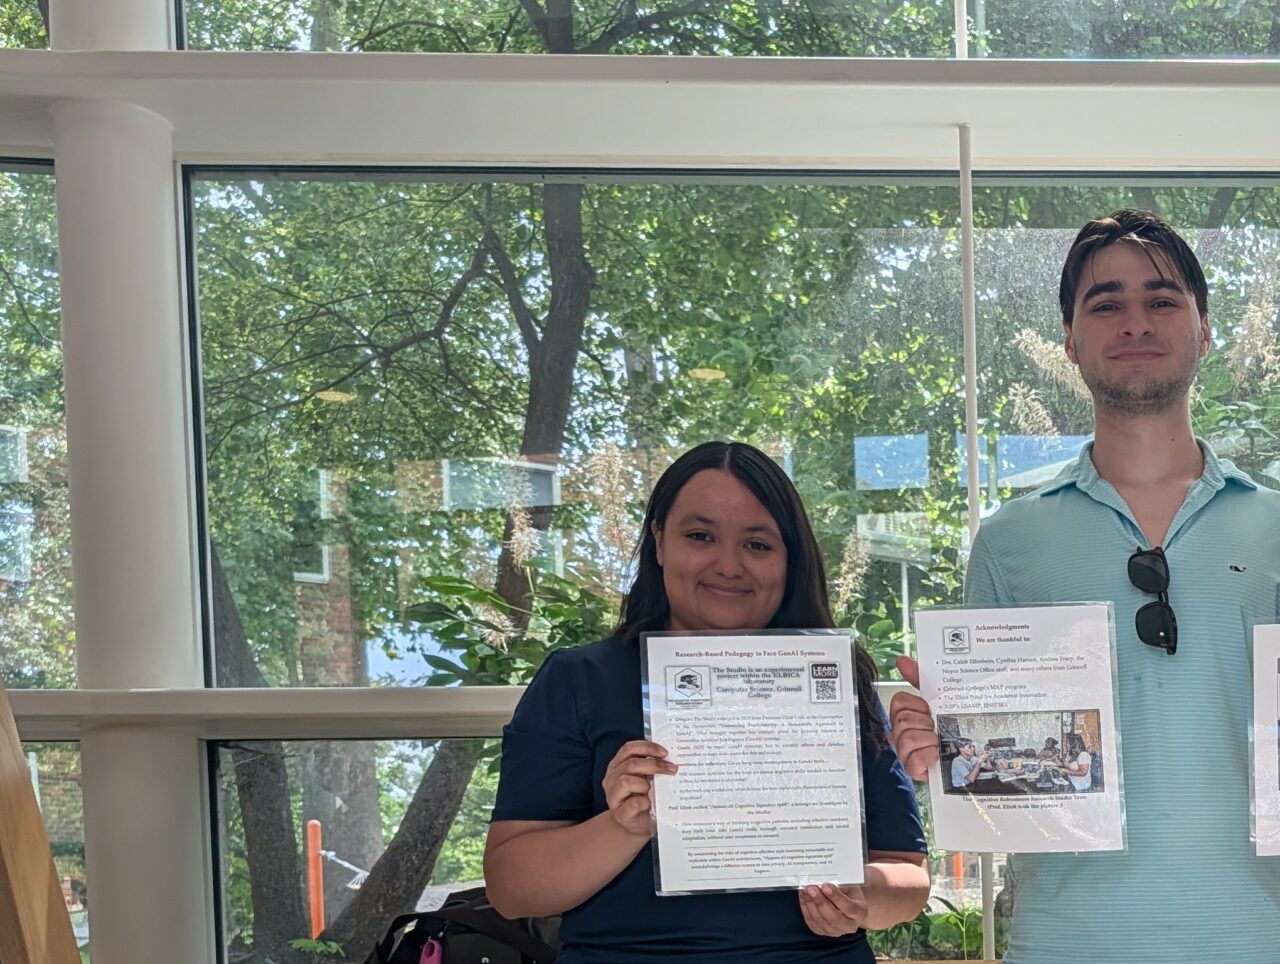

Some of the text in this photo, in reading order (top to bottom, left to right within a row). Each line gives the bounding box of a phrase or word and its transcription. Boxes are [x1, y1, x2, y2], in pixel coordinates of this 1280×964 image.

[974, 623, 1030, 631] Acknowledgments
[996, 635, 1022, 643] thankful
[724, 649, 754, 657] Pedagogy
[762, 649, 776, 657] Face
